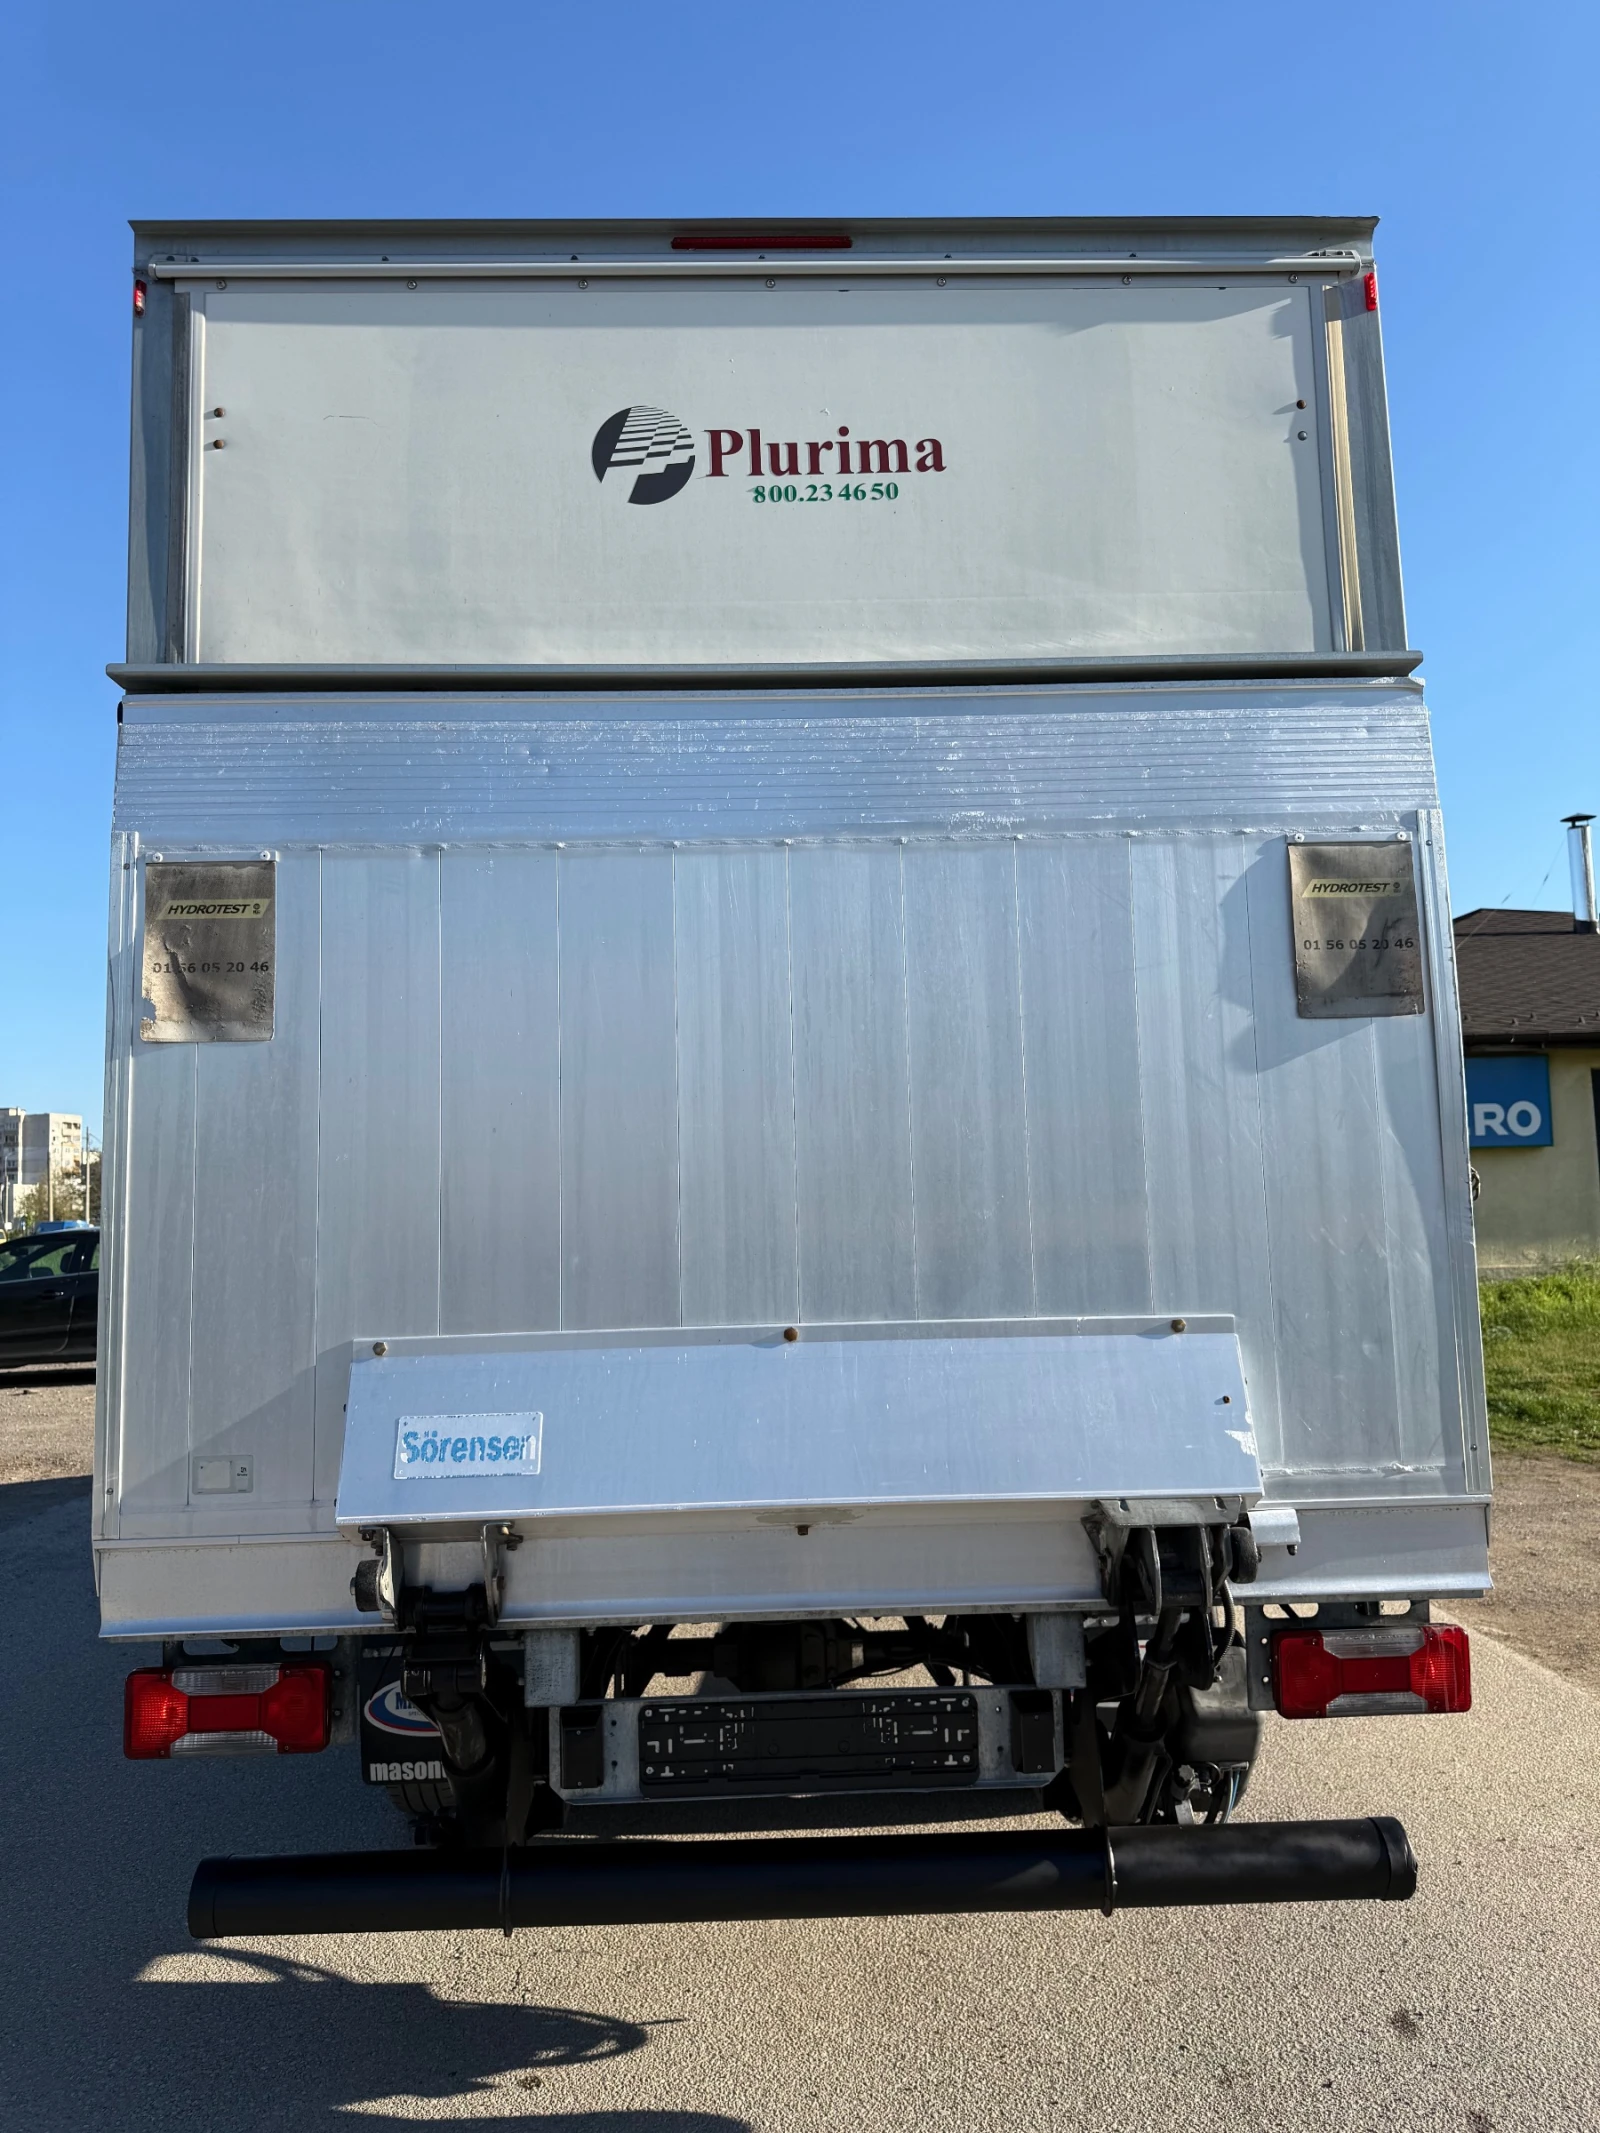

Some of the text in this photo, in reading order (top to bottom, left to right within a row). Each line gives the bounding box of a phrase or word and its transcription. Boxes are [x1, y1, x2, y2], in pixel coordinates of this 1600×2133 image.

[703, 426, 947, 478] Plurima
[1311, 882, 1390, 893] HYDROTEST
[167, 904, 250, 915] HYDROTEST
[1303, 937, 1414, 950] 01 56 05 20 46
[152, 962, 172, 974] 01
[201, 962, 220, 973] 05
[226, 961, 245, 973] 20
[249, 961, 269, 972] 46
[1473, 1100, 1542, 1137] RO
[400, 1430, 537, 1464] Sörensen
